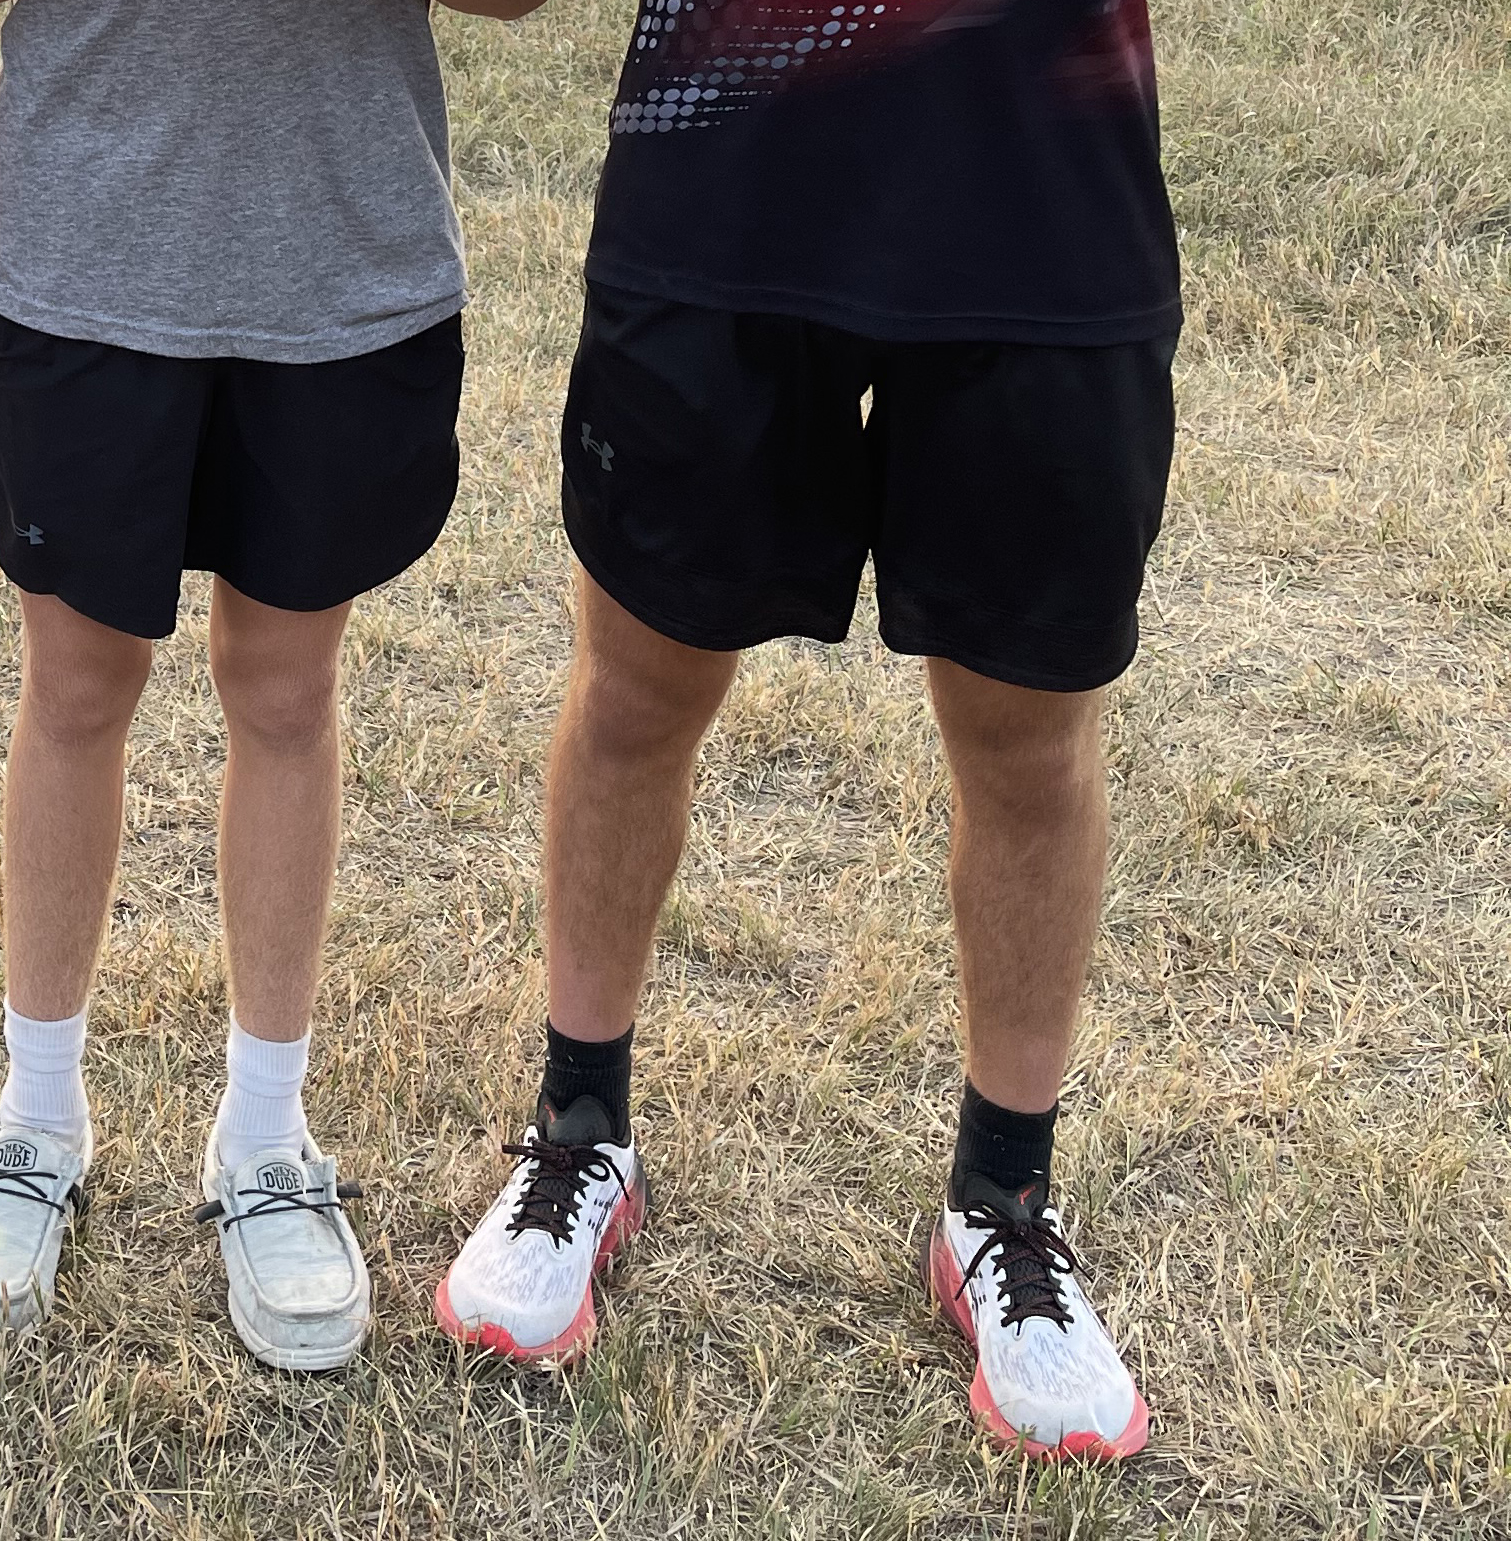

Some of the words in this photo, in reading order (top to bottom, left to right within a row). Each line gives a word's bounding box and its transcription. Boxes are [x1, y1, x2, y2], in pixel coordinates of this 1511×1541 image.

[5, 1143, 25, 1154] HEY
[271, 1166, 291, 1177] HEY
[262, 1171, 300, 1190] DUDE
